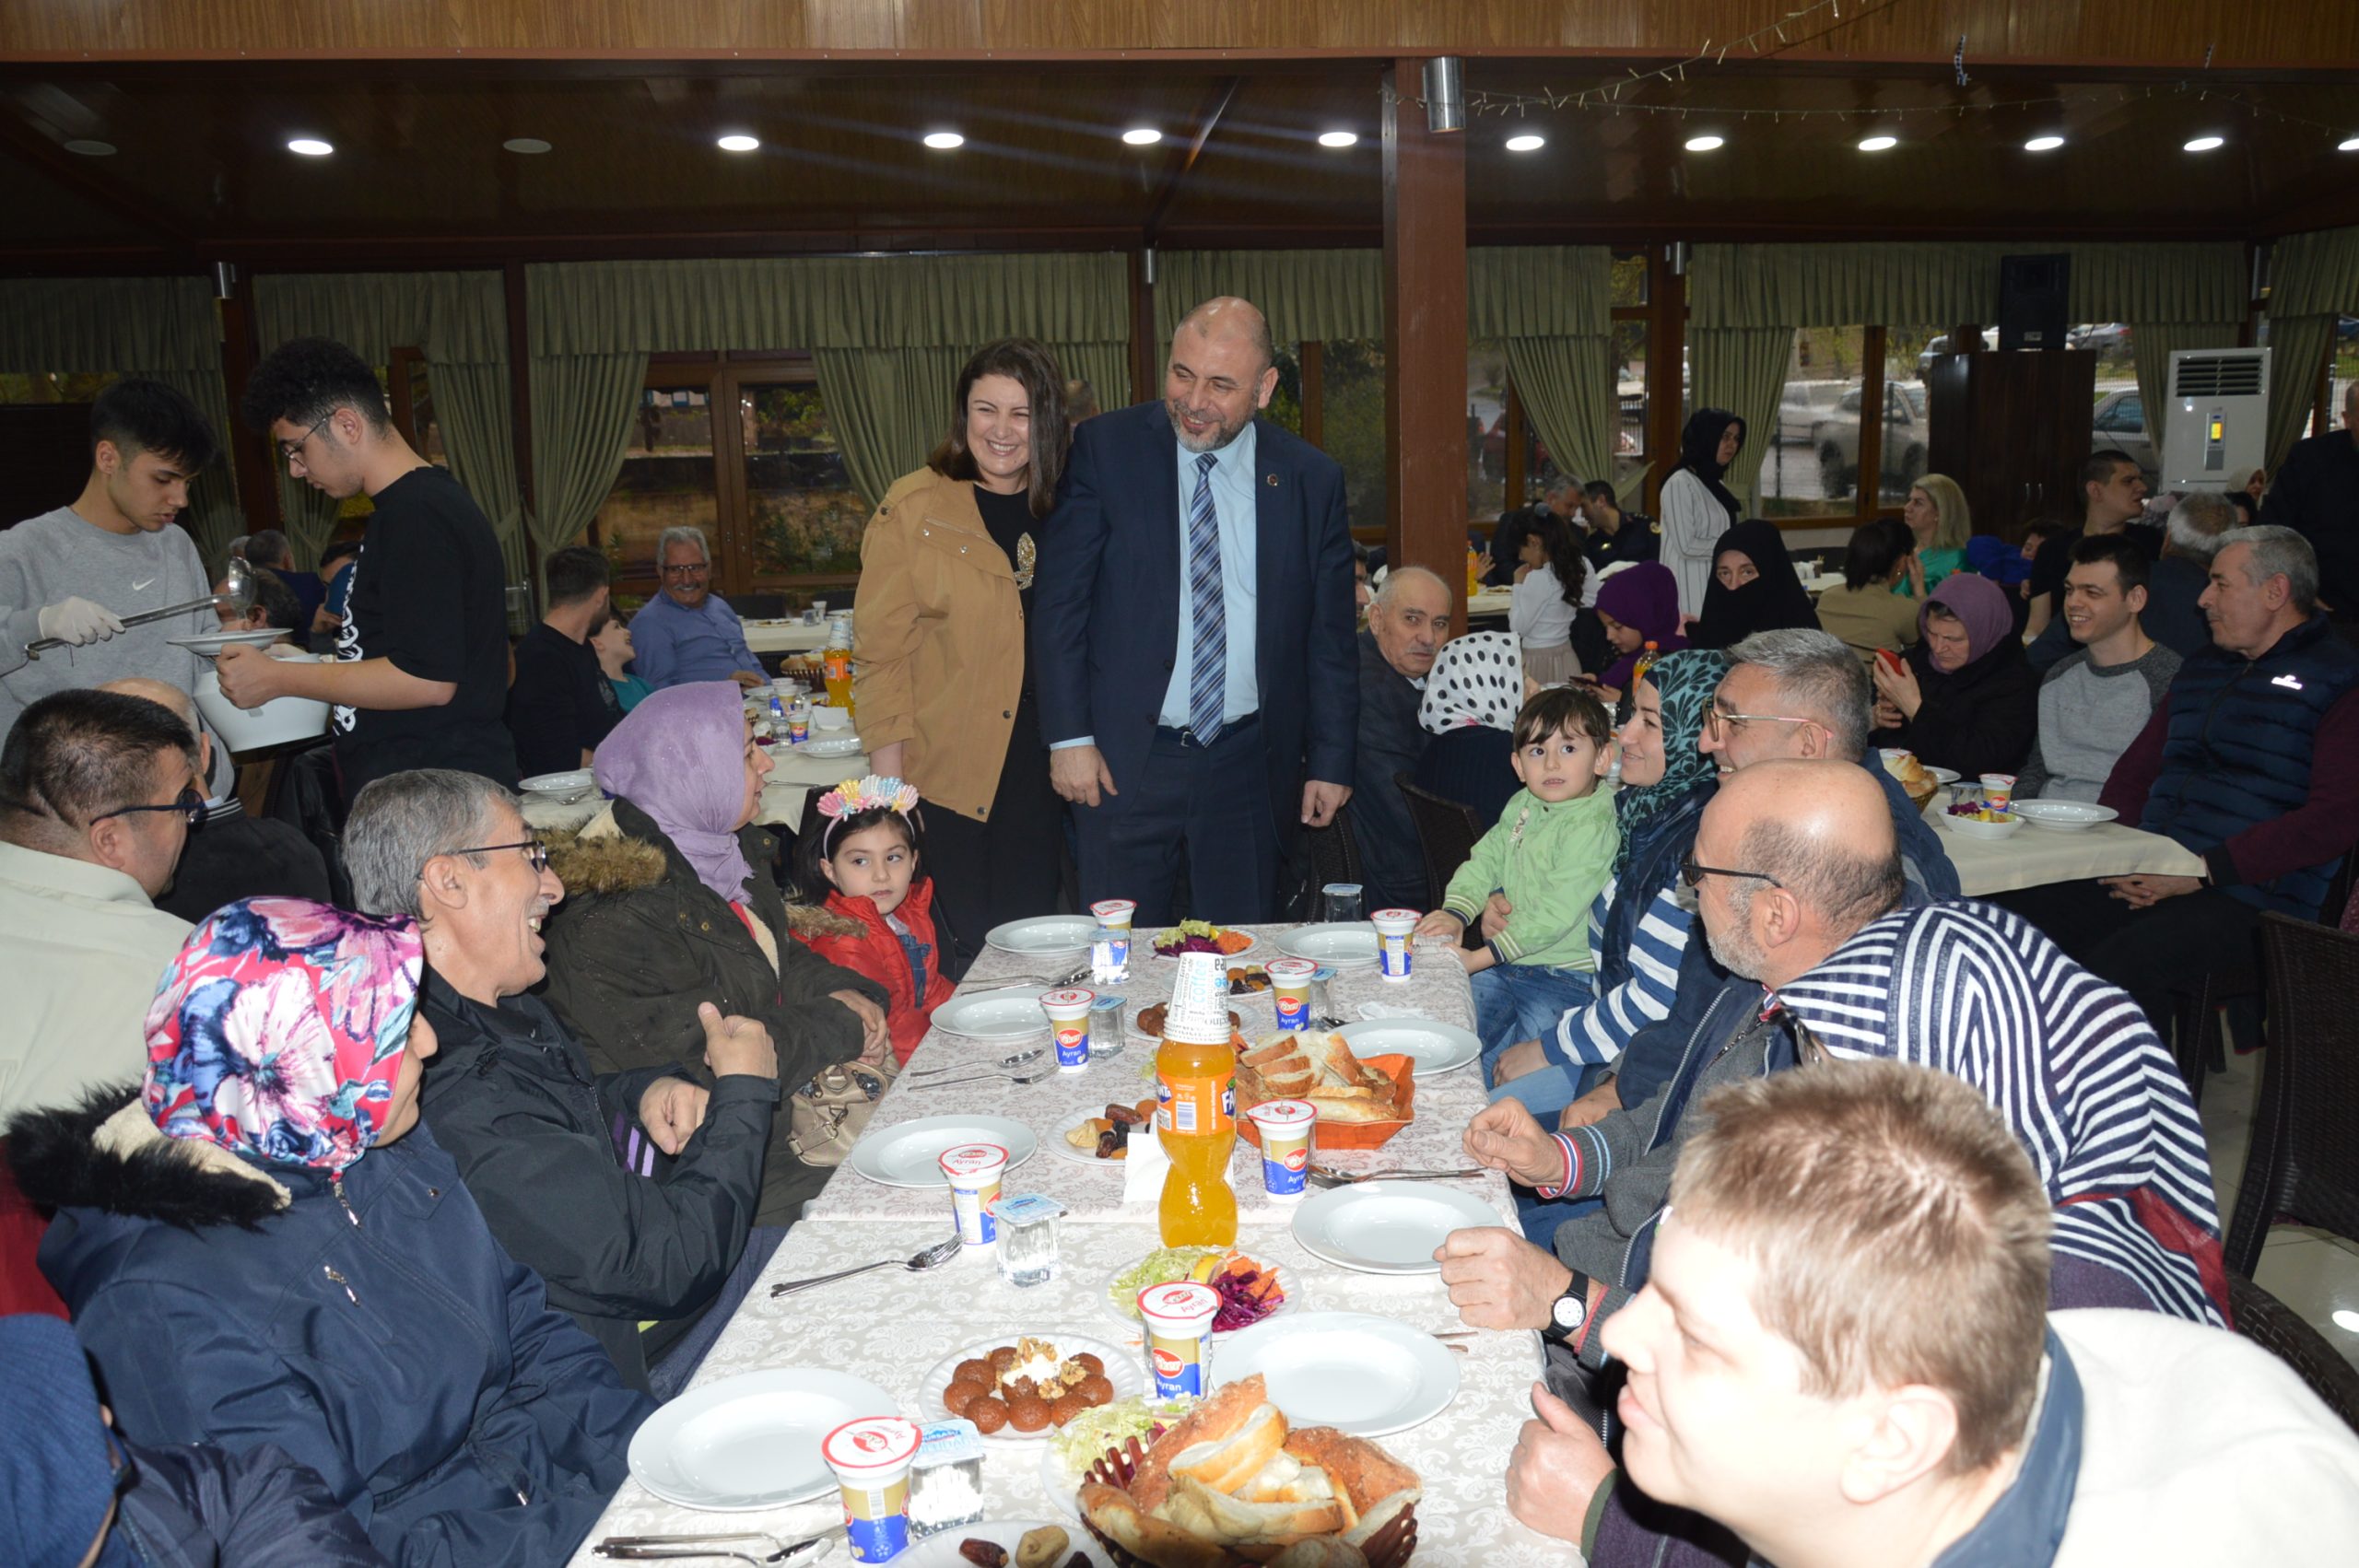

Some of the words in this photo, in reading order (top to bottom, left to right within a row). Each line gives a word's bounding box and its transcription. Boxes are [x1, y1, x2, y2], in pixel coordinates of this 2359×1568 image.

[1191, 959, 1208, 1004] coffee
[1280, 1016, 1300, 1025] Ayran
[1180, 1298, 1208, 1313] Ayran
